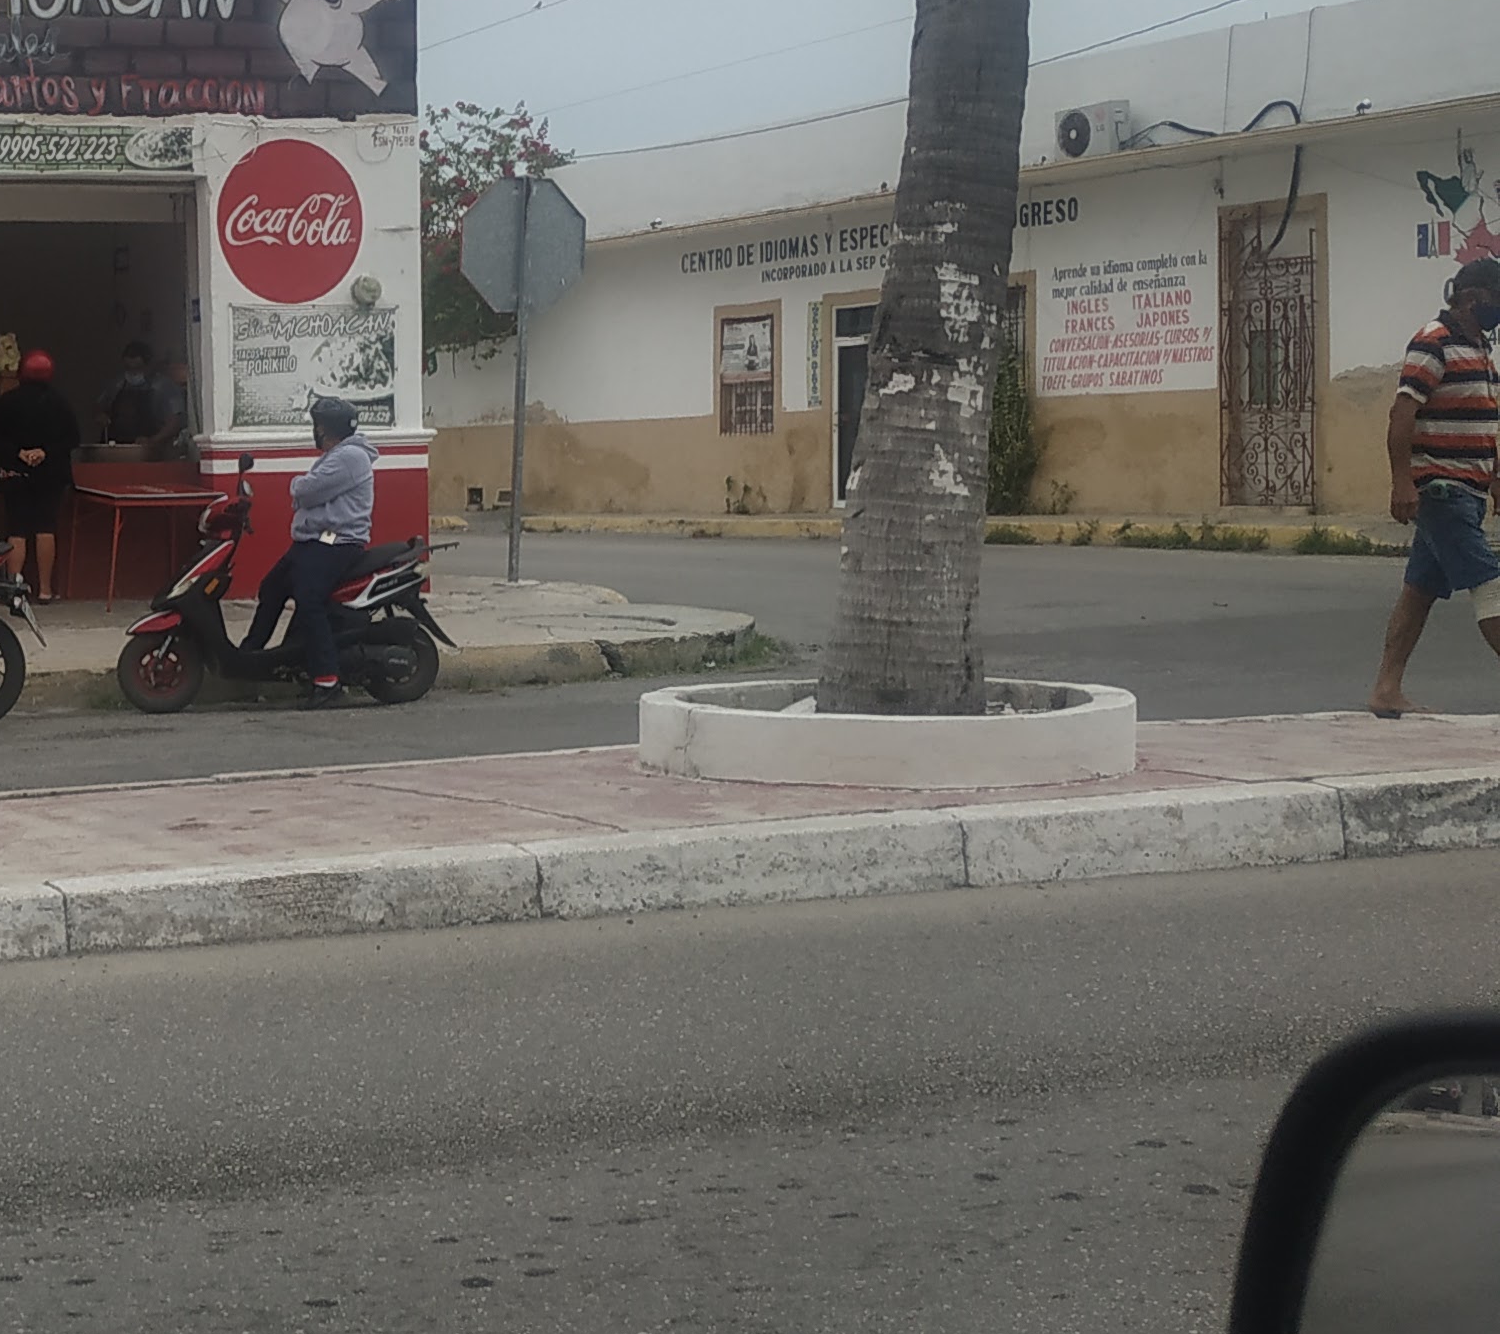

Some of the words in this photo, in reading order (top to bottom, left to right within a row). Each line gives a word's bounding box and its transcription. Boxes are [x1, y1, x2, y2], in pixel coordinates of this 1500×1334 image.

[225, 193, 354, 246] Coca-Cola
[681, 246, 733, 274] CENTRO
[737, 243, 754, 267] DE
[759, 233, 818, 264] IDIOMAS
[824, 232, 832, 255] Y
[839, 223, 889, 252] ESPEC
[1014, 196, 1079, 228] GRESO
[761, 260, 827, 283] INCORPORADO
[830, 261, 836, 274] A
[839, 258, 853, 273] LA
[856, 255, 876, 271] SEP
[879, 254, 888, 268] C
[1052, 263, 1088, 283] Aprende
[1102, 259, 1134, 276] idioma
[1136, 253, 1178, 273] completo
[1181, 254, 1196, 267] con
[1199, 249, 1208, 265] la
[1052, 285, 1077, 301] mejor
[1079, 278, 1114, 297] calidad
[1117, 277, 1128, 292] de
[1132, 273, 1186, 291] enseñanza
[1067, 297, 1109, 316] INGLES
[1132, 289, 1192, 310] ITALIANO
[273, 313, 391, 342] MICHOACAN
[1065, 316, 1115, 334] FRANCES
[1136, 309, 1190, 328] JAPONES
[1109, 368, 1164, 387] SABATINOS
